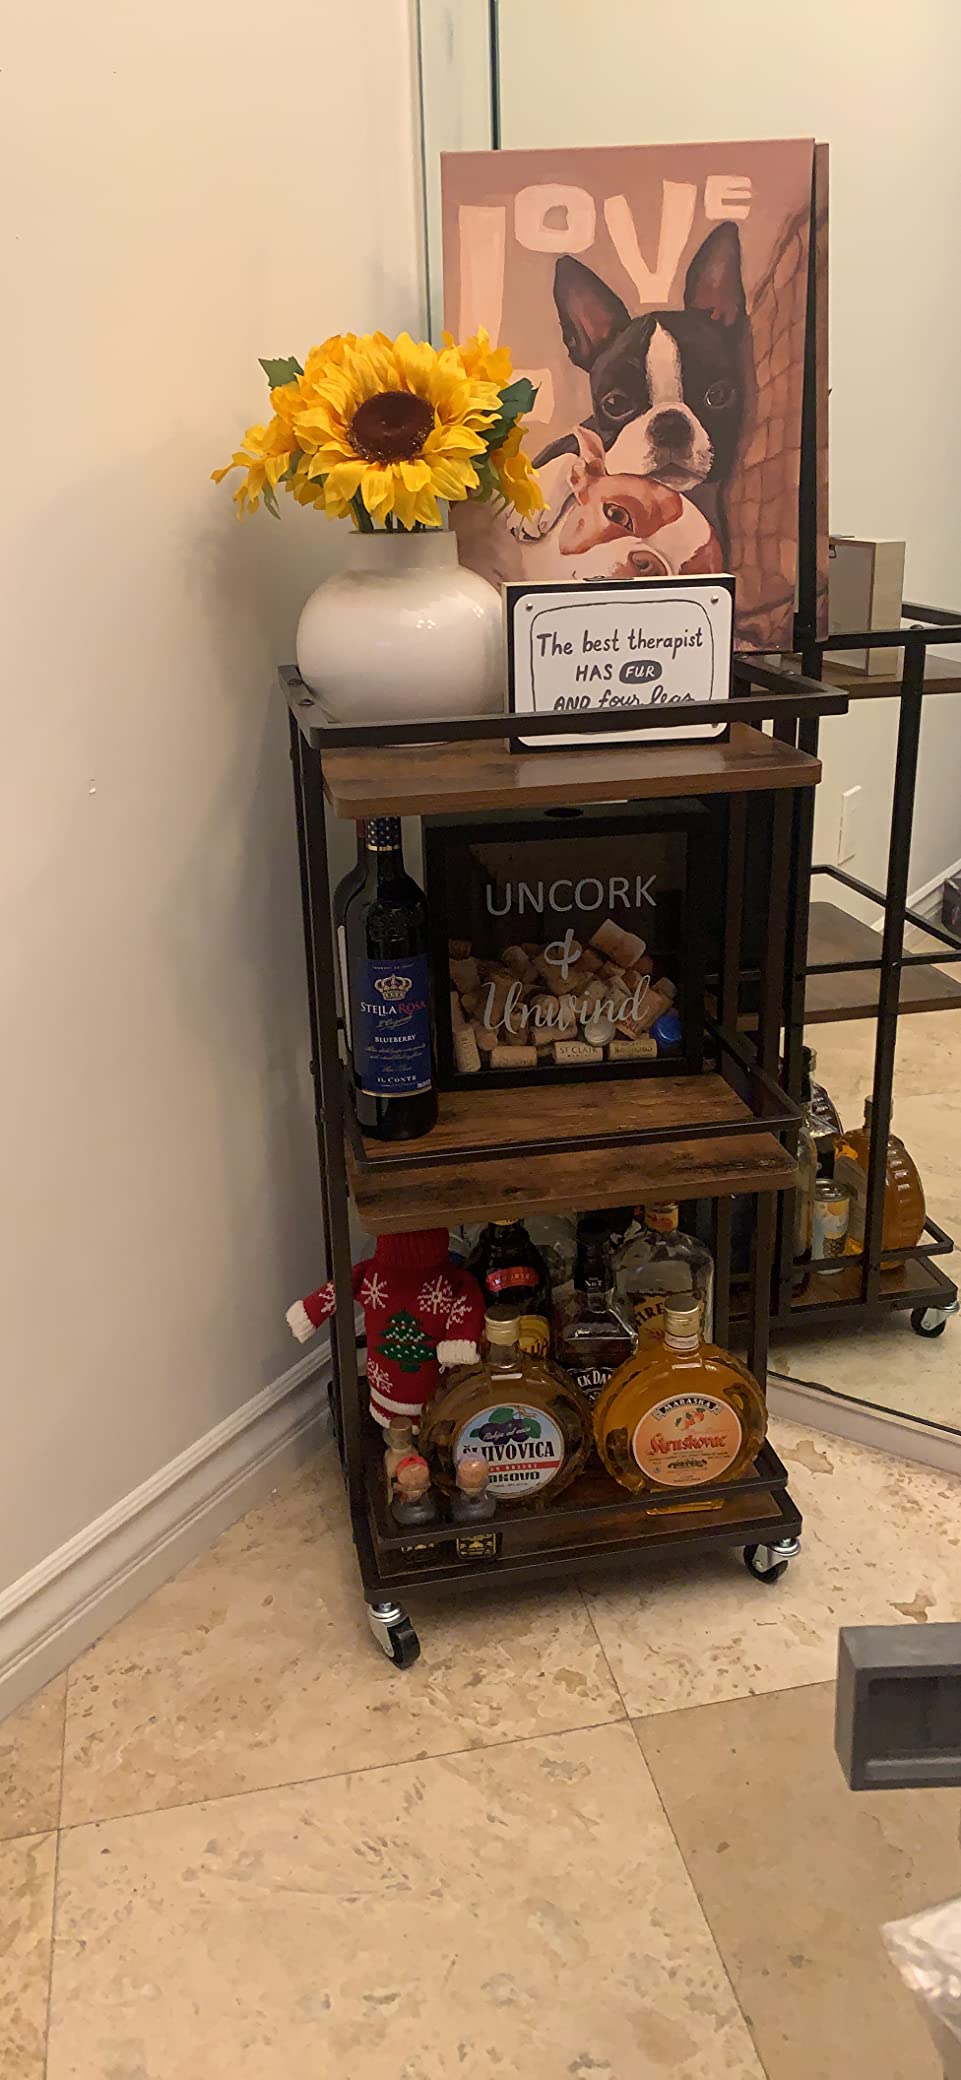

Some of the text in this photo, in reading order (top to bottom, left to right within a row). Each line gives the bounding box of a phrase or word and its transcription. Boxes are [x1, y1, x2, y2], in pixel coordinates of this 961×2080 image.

[458, 175, 752, 424] LOVE
[536, 627, 703, 660] The best therapist
[575, 663, 656, 682] HAS FUR
[553, 695, 591, 711] AND
[598, 689, 640, 708] four
[486, 875, 657, 916] UNCORK
[360, 1001, 397, 1017] STELLA
[481, 974, 651, 1035] Unwind
[374, 1034, 417, 1044] BLUEBERRY
[387, 1074, 417, 1084] CONTE
[577, 1373, 592, 1387] CK
[663, 1397, 711, 1411] MARASKA
